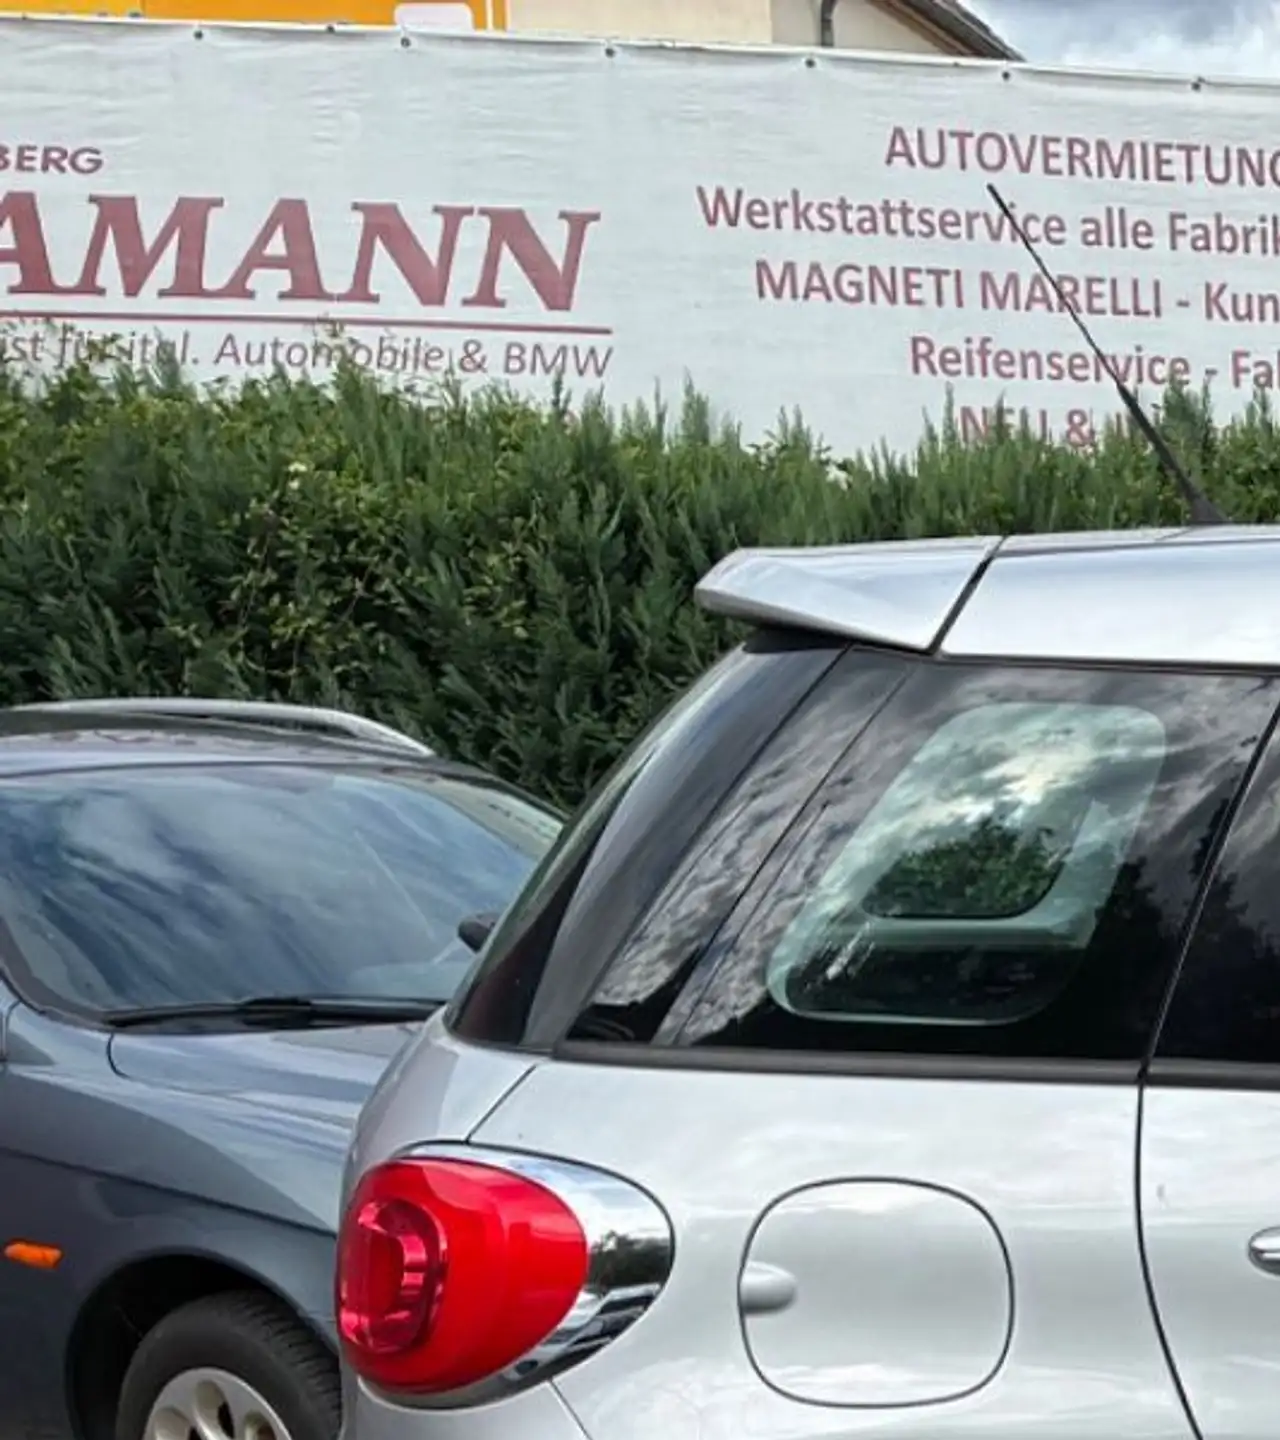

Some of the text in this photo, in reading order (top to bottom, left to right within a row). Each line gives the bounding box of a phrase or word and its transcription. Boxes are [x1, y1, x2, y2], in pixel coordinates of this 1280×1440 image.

[696, 185, 1067, 247] Werkstattservice
[1080, 206, 1155, 249] alle
[756, 260, 964, 308] MAGNETI
[980, 270, 1163, 318] MARELLI
[54, 321, 118, 369] fü
[129, 328, 200, 366] itl.
[213, 332, 445, 373] Automobile
[458, 337, 488, 375] &
[504, 341, 614, 378] BMW
[910, 335, 1191, 386] Reifenservice
